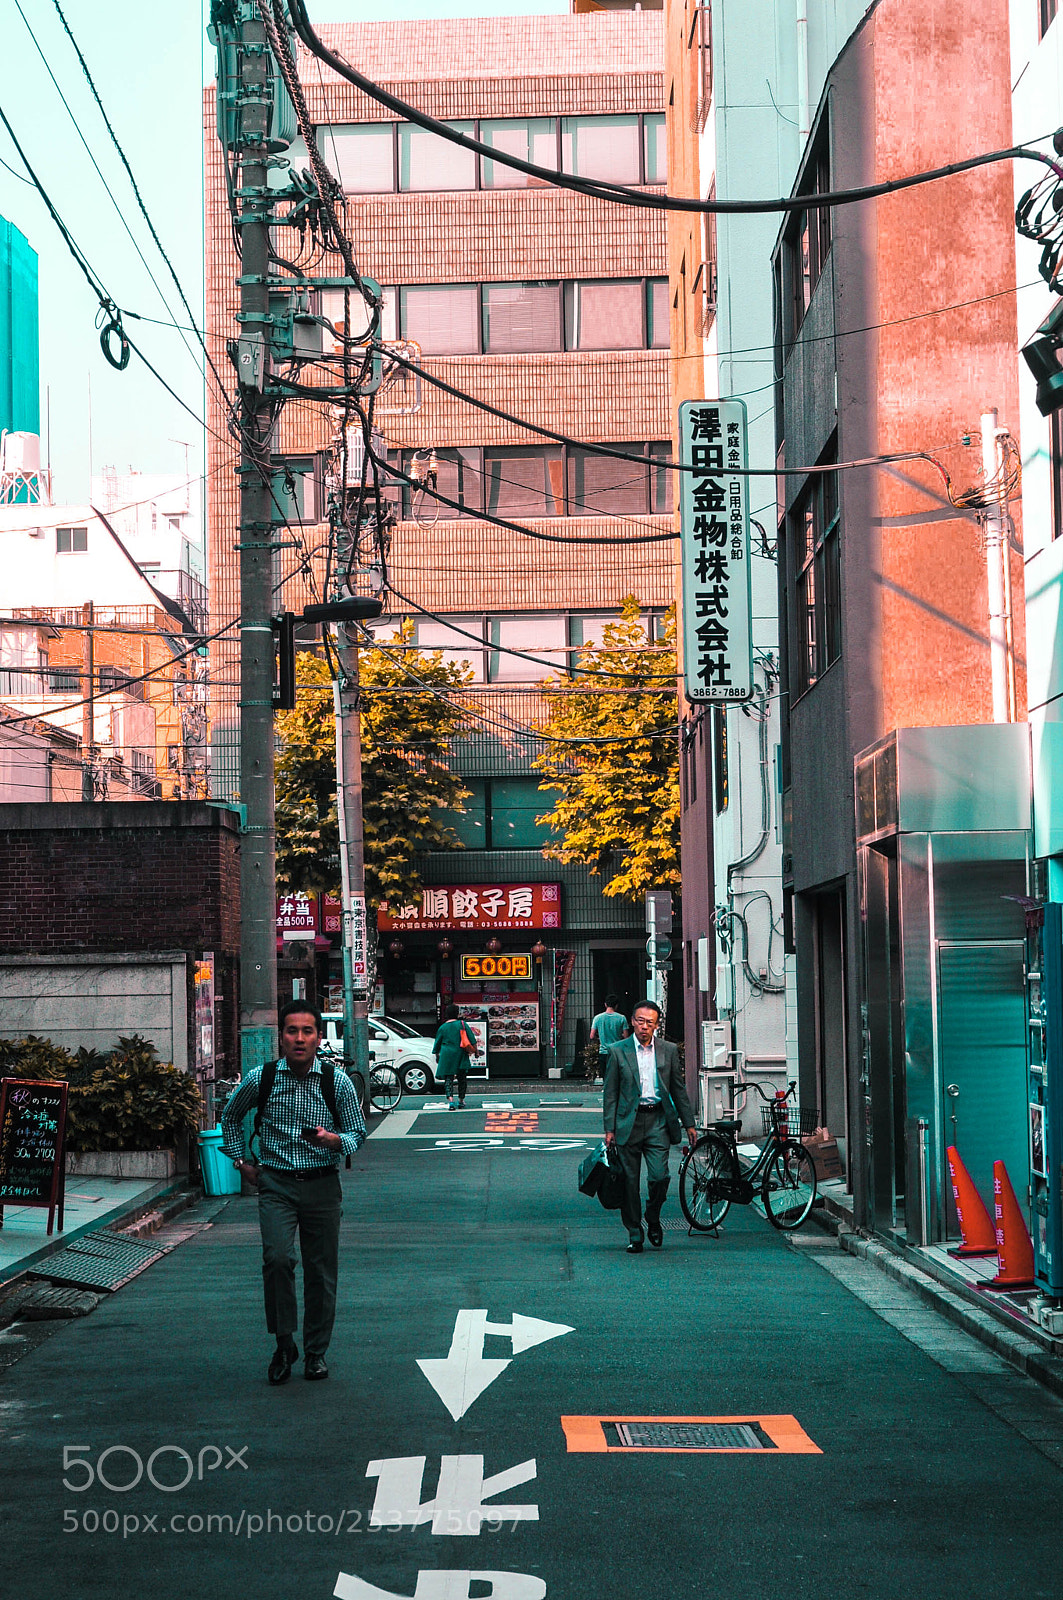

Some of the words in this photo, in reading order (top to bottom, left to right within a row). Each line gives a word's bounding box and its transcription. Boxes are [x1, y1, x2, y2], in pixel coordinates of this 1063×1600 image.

[688, 408, 732, 687] 澤田金物株式会社
[693, 688, 746, 697] 3862-7888
[279, 902, 310, 916] 弁当
[466, 957, 527, 976] 500円
